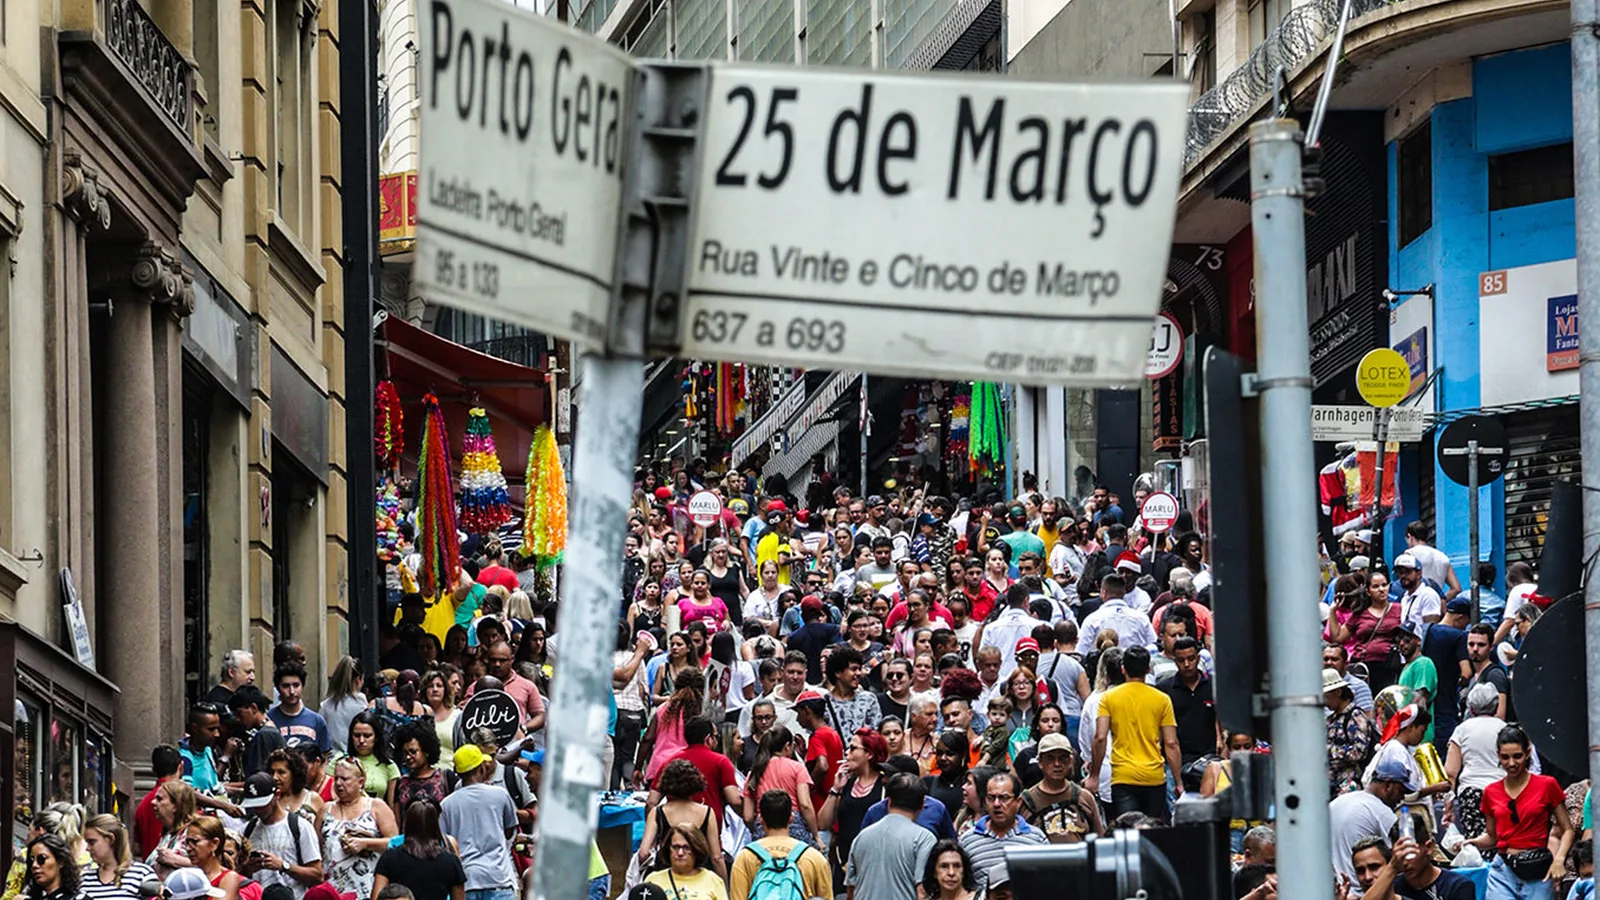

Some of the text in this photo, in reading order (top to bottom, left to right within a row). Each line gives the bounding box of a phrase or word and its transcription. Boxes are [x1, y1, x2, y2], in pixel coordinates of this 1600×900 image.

[431, 1, 534, 142] Porto
[715, 83, 1158, 239] 25 de Março
[429, 167, 567, 246] Ladeira Porto Geral
[458, 262, 467, 290] a
[700, 240, 1120, 307] Rua Vinte e Cinco de Março
[1194, 246, 1225, 269] 73
[1484, 275, 1503, 293] 85
[691, 308, 846, 354] 637 a 693
[1361, 366, 1406, 380] LOTEX
[1145, 505, 1174, 513] MARLU
